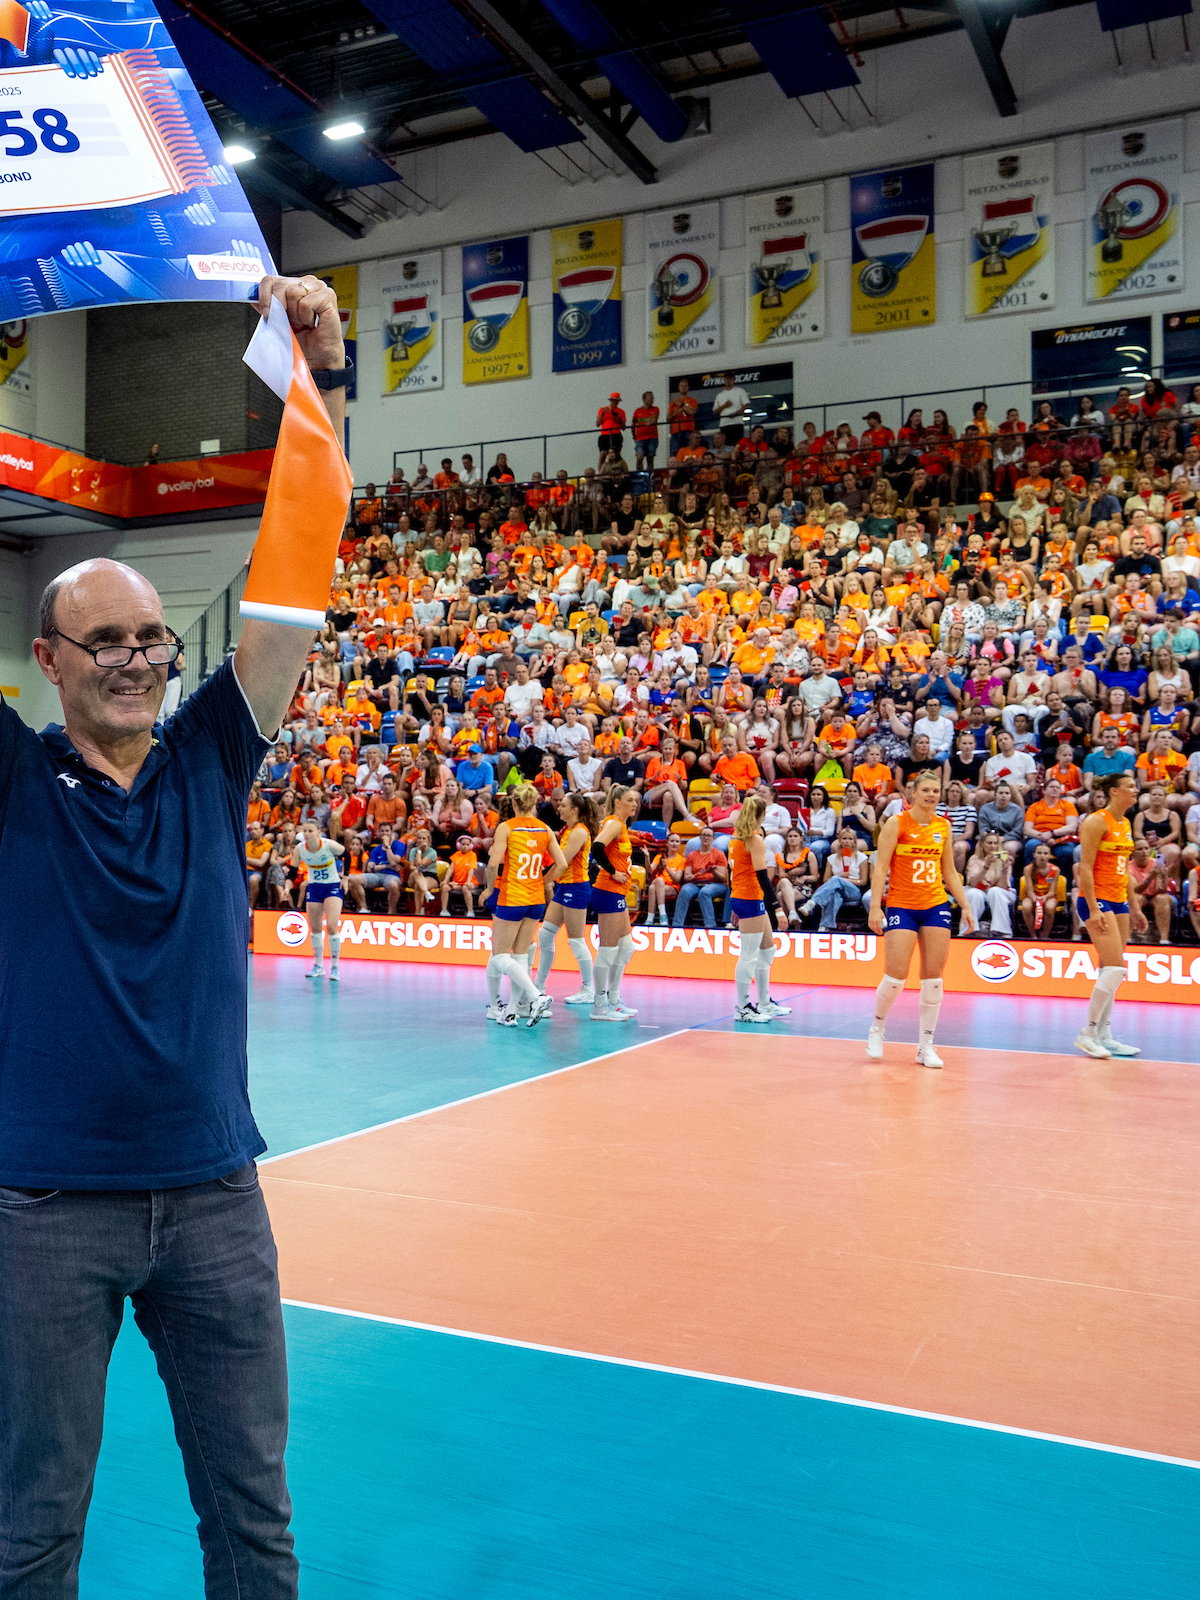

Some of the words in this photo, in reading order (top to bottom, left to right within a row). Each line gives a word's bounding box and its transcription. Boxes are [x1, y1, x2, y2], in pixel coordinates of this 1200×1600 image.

[211, 261, 260, 273] nevobo
[1113, 274, 1156, 292] 2002
[990, 292, 1028, 309] 2001
[875, 308, 912, 325] 2001
[769, 323, 802, 339] 2000
[1055, 326, 1128, 344] DYNAMOCAFE
[668, 337, 699, 351] 2000
[572, 350, 603, 364] 1999
[481, 363, 510, 376] 1997
[398, 375, 425, 388] 1996
[703, 371, 760, 387] DYNAOCAFE
[167, 476, 215, 493] volleybal
[910, 847, 940, 855] DHL
[313, 869, 329, 880] 25
[517, 853, 542, 880] 20
[912, 859, 936, 883] 23
[888, 915, 900, 926] 23
[631, 926, 877, 962] STAATSOTERIJ
[1022, 948, 1200, 985] STATSL
